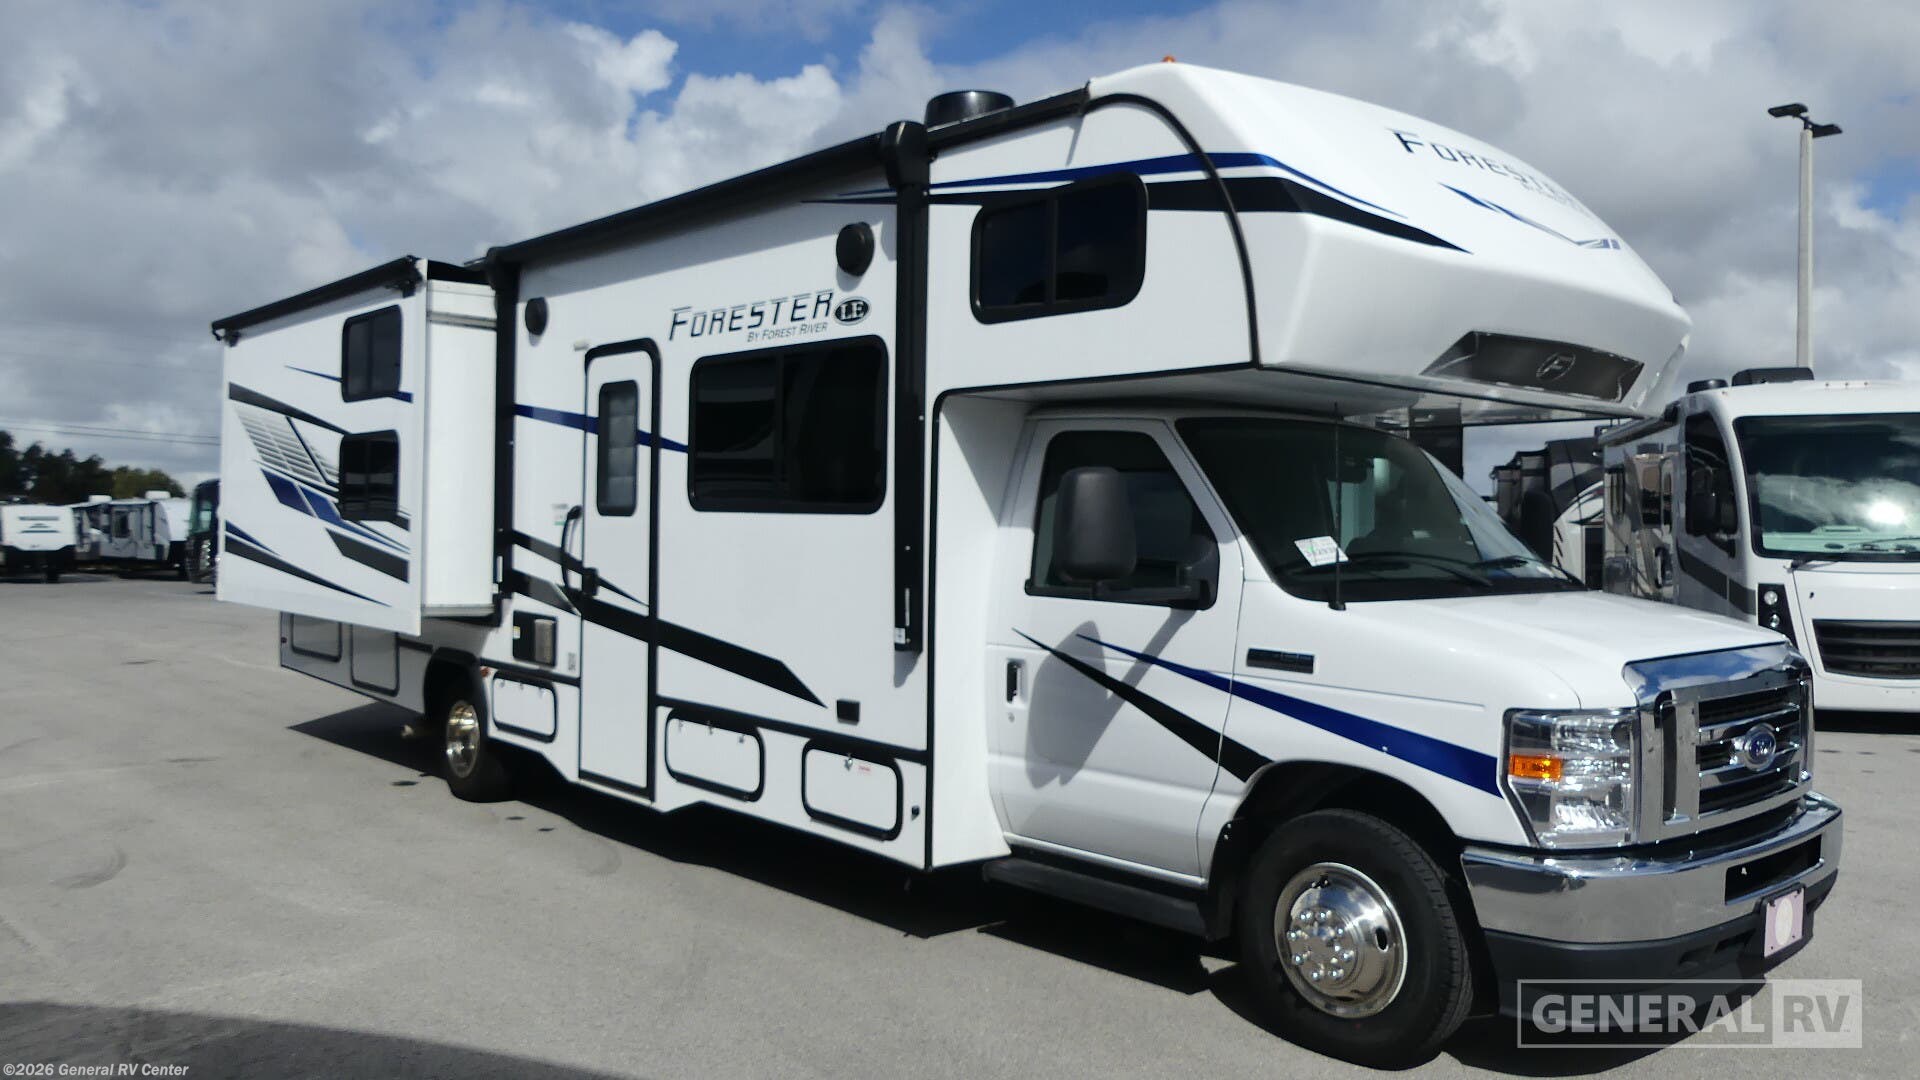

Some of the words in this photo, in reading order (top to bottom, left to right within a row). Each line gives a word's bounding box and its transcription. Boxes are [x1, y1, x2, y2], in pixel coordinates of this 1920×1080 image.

[669, 289, 833, 341] FORESTER
[747, 331, 760, 342] BY
[762, 325, 797, 340] FOREST
[799, 322, 828, 334] RIVER
